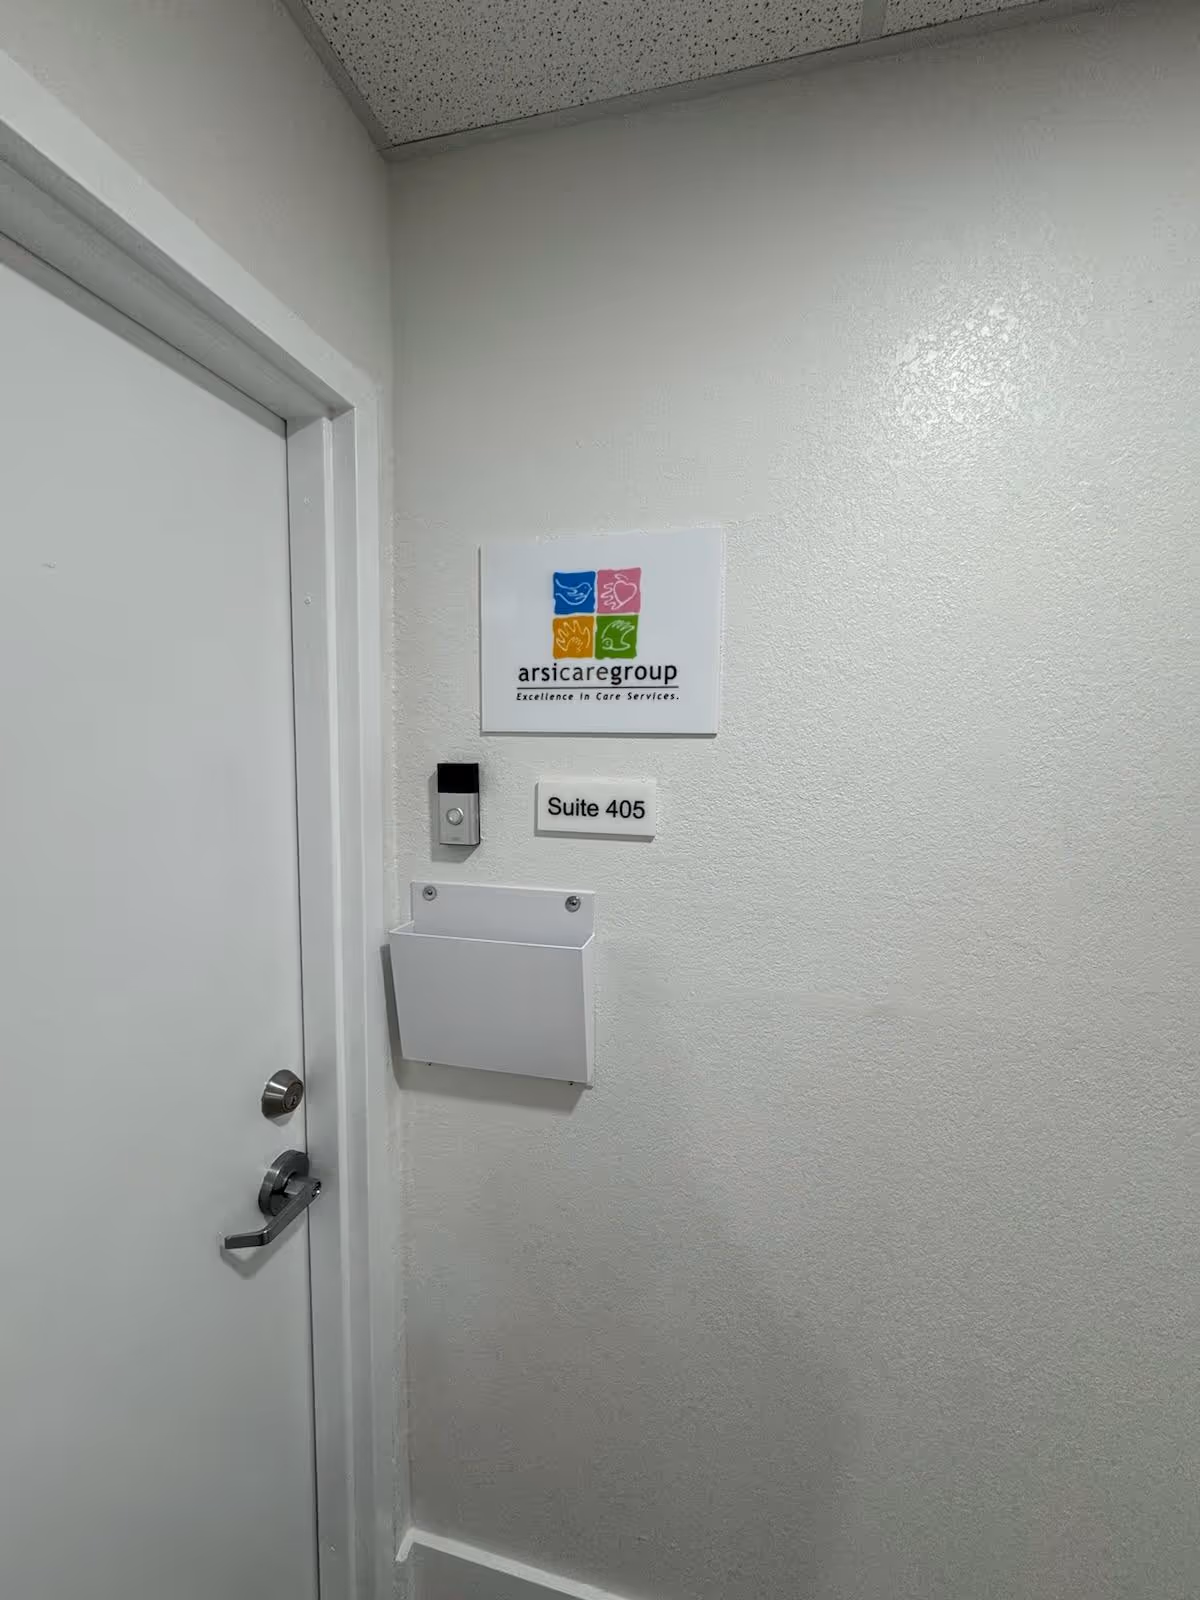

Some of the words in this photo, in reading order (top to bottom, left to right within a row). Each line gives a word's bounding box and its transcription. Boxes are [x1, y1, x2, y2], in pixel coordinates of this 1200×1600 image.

[518, 662, 677, 685] arsicaregroup
[516, 692, 574, 701] Excellence
[596, 692, 621, 701] Care
[627, 692, 679, 701] Services.
[548, 797, 599, 817] Suite
[605, 800, 645, 819] 405
